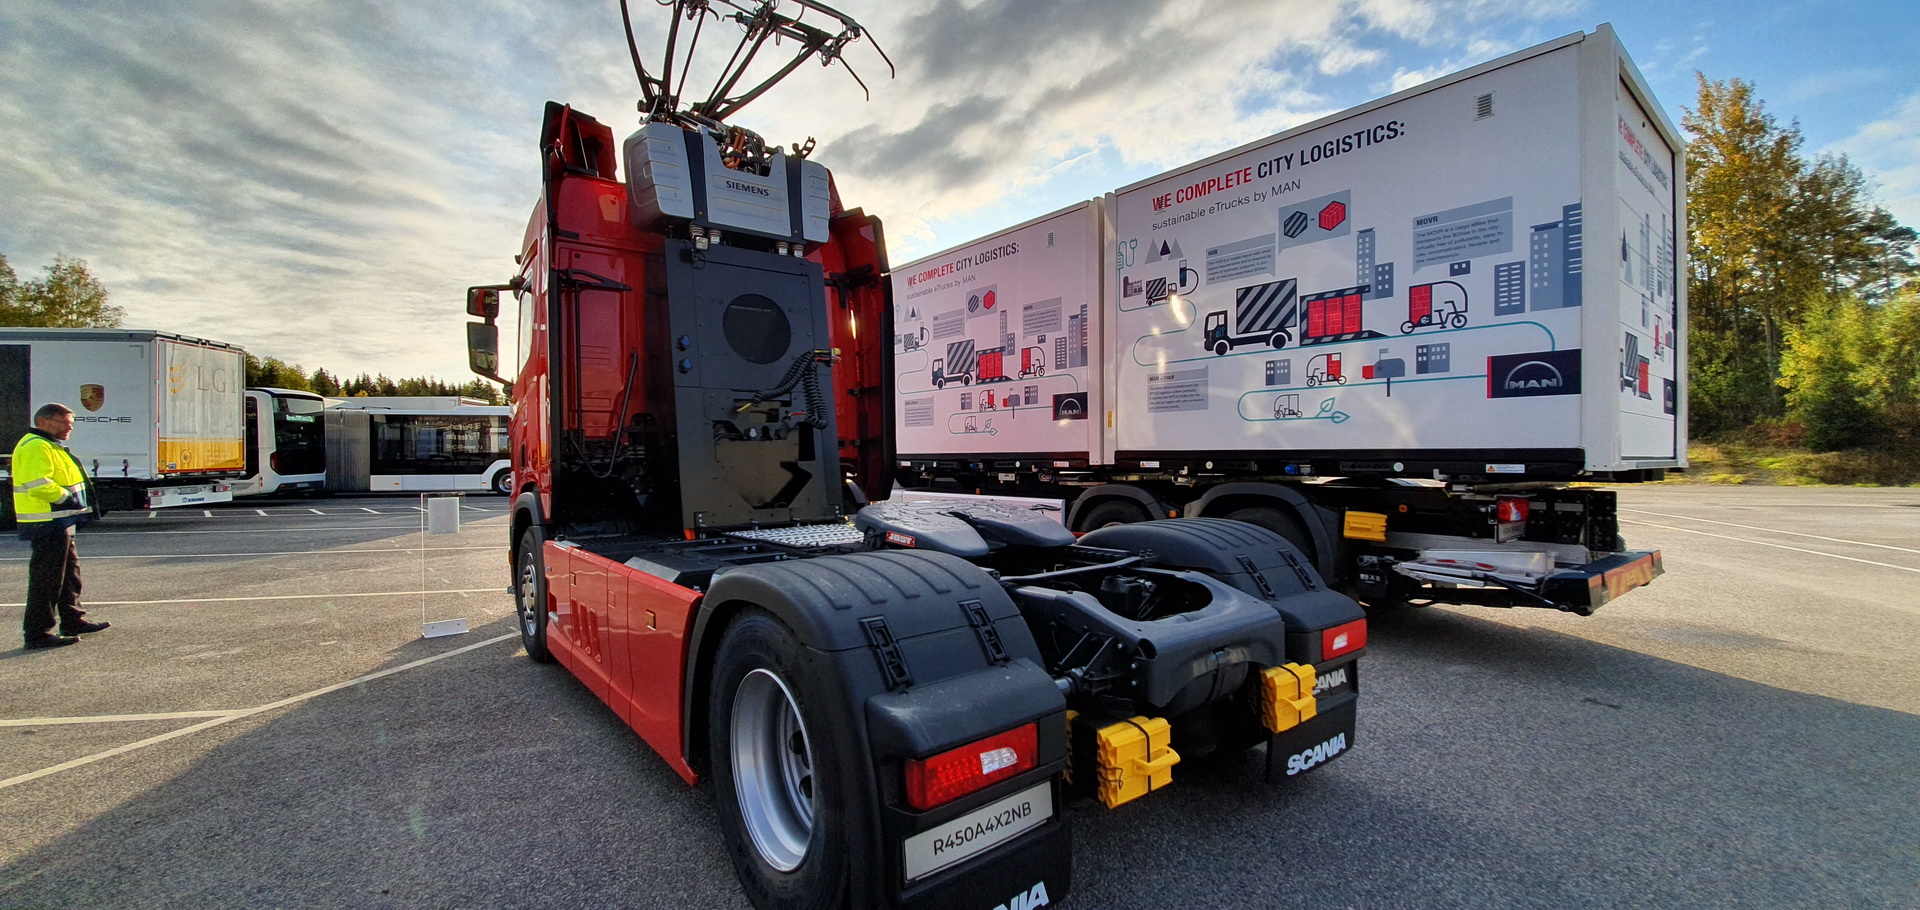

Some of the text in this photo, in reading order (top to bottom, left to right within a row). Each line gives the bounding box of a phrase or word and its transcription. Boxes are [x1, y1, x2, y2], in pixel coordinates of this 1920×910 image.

[1152, 120, 1405, 212] WE COMPLETE CITY LOGISTICS:
[726, 180, 770, 197] SIEMENS
[1152, 179, 1301, 231] sustainable eTrucks by MAN
[1416, 215, 1438, 226] MOVR
[906, 242, 1020, 287] WE COMPLETE CITY LOGISTICS:
[906, 274, 976, 301] sustainable eTrucks by MAN
[196, 365, 237, 394] LGI
[1509, 378, 1557, 389] MAN
[888, 532, 913, 545] JOST
[1286, 732, 1347, 777] SCANIA
[932, 801, 1032, 856] R450A4X2NB
